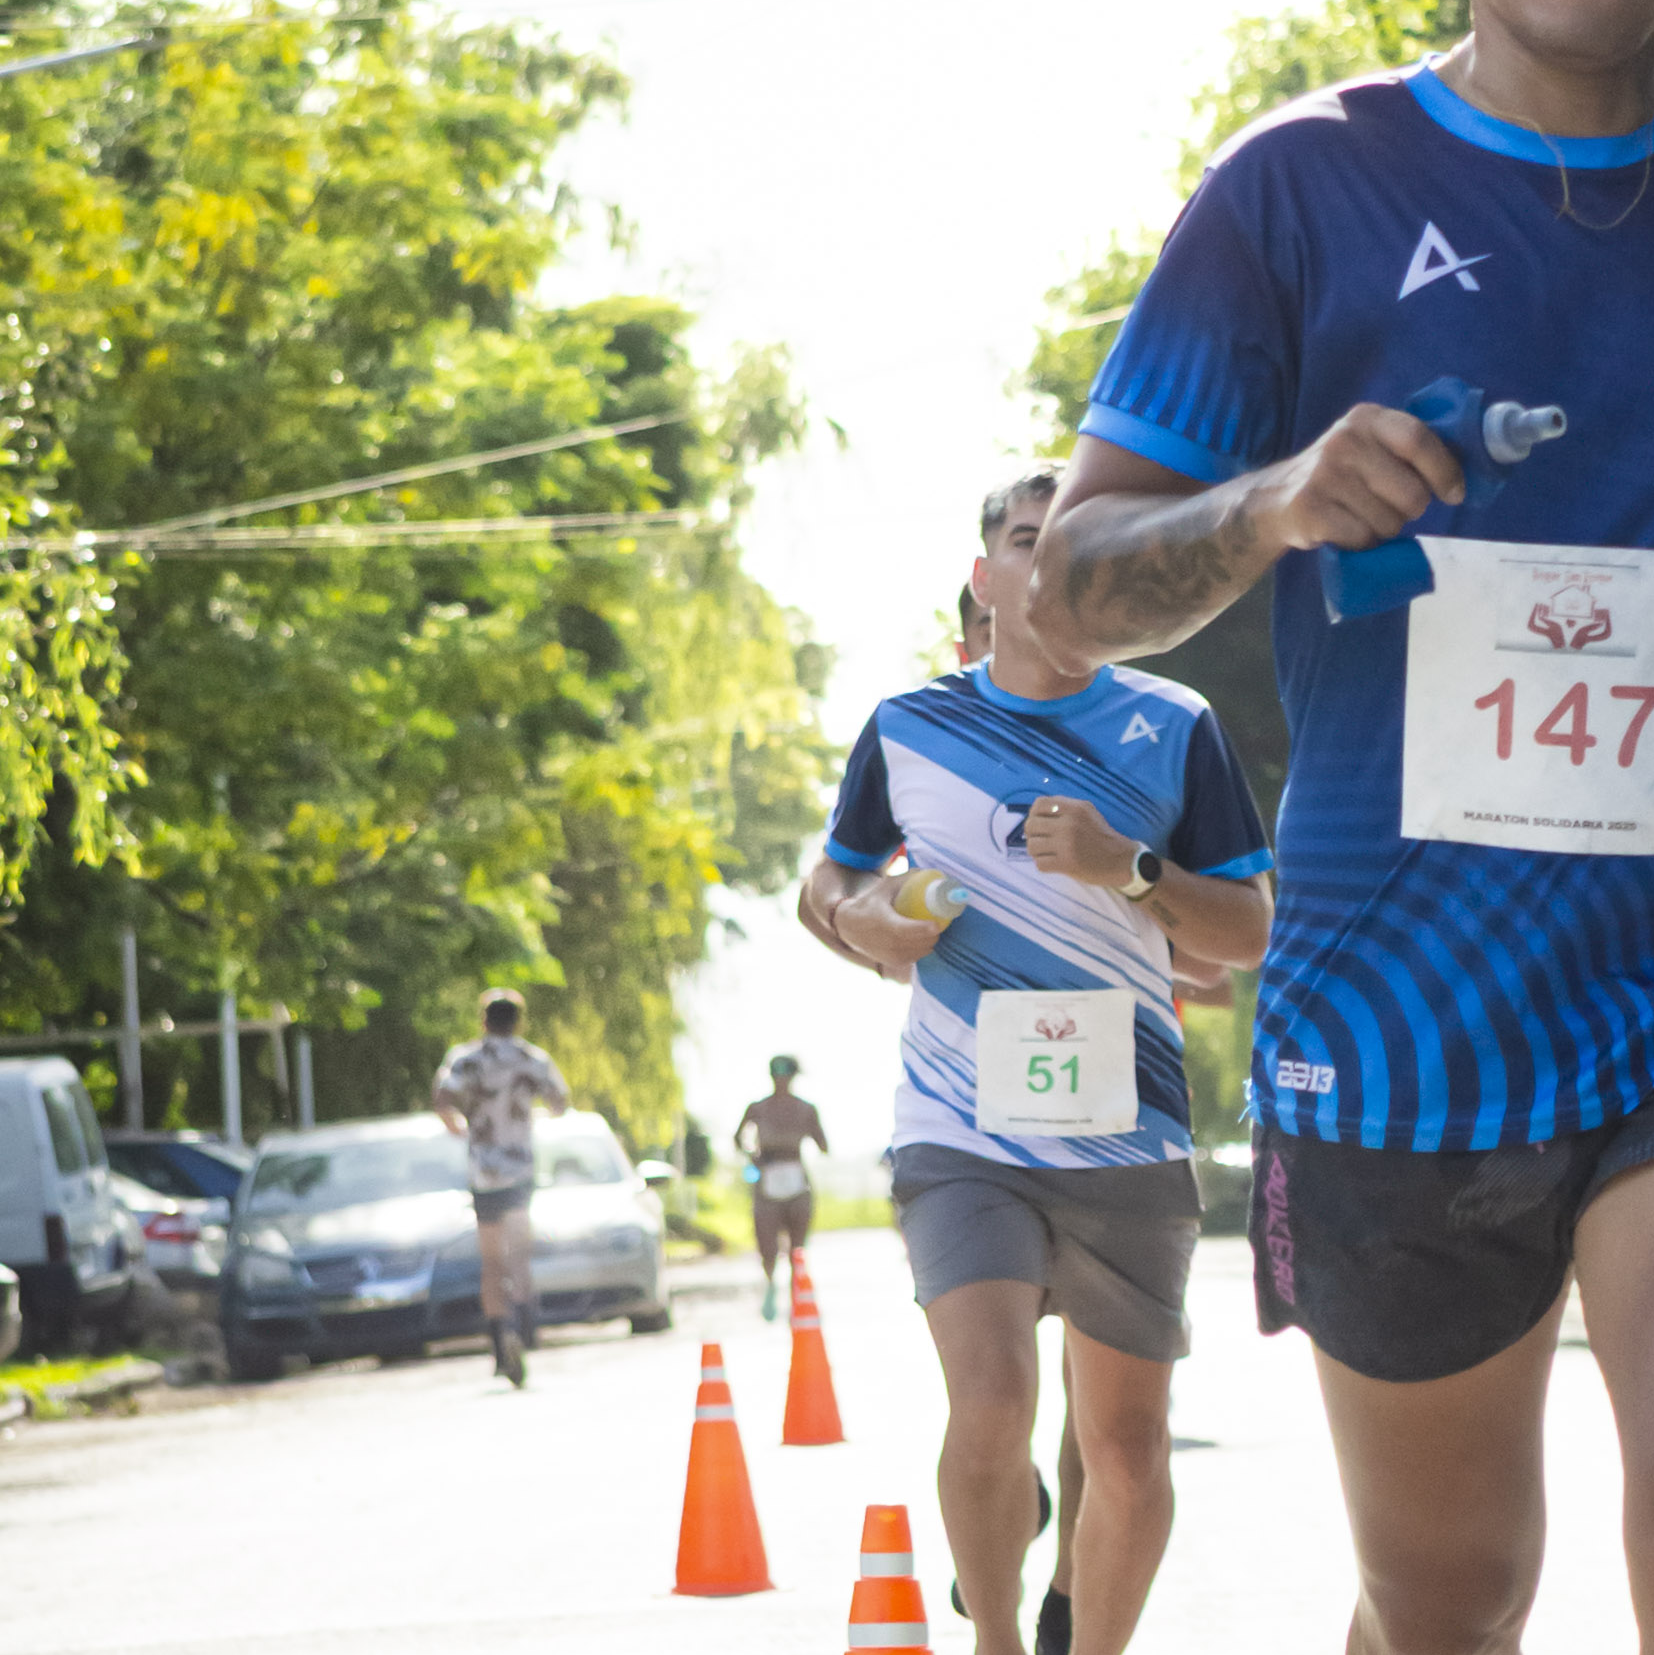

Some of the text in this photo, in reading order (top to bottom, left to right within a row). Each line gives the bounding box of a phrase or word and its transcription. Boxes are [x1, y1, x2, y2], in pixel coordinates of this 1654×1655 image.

[1463, 810, 1529, 826] MARATON
[1532, 816, 1603, 830] SOLIDARIA
[1027, 1055, 1079, 1094] 51
